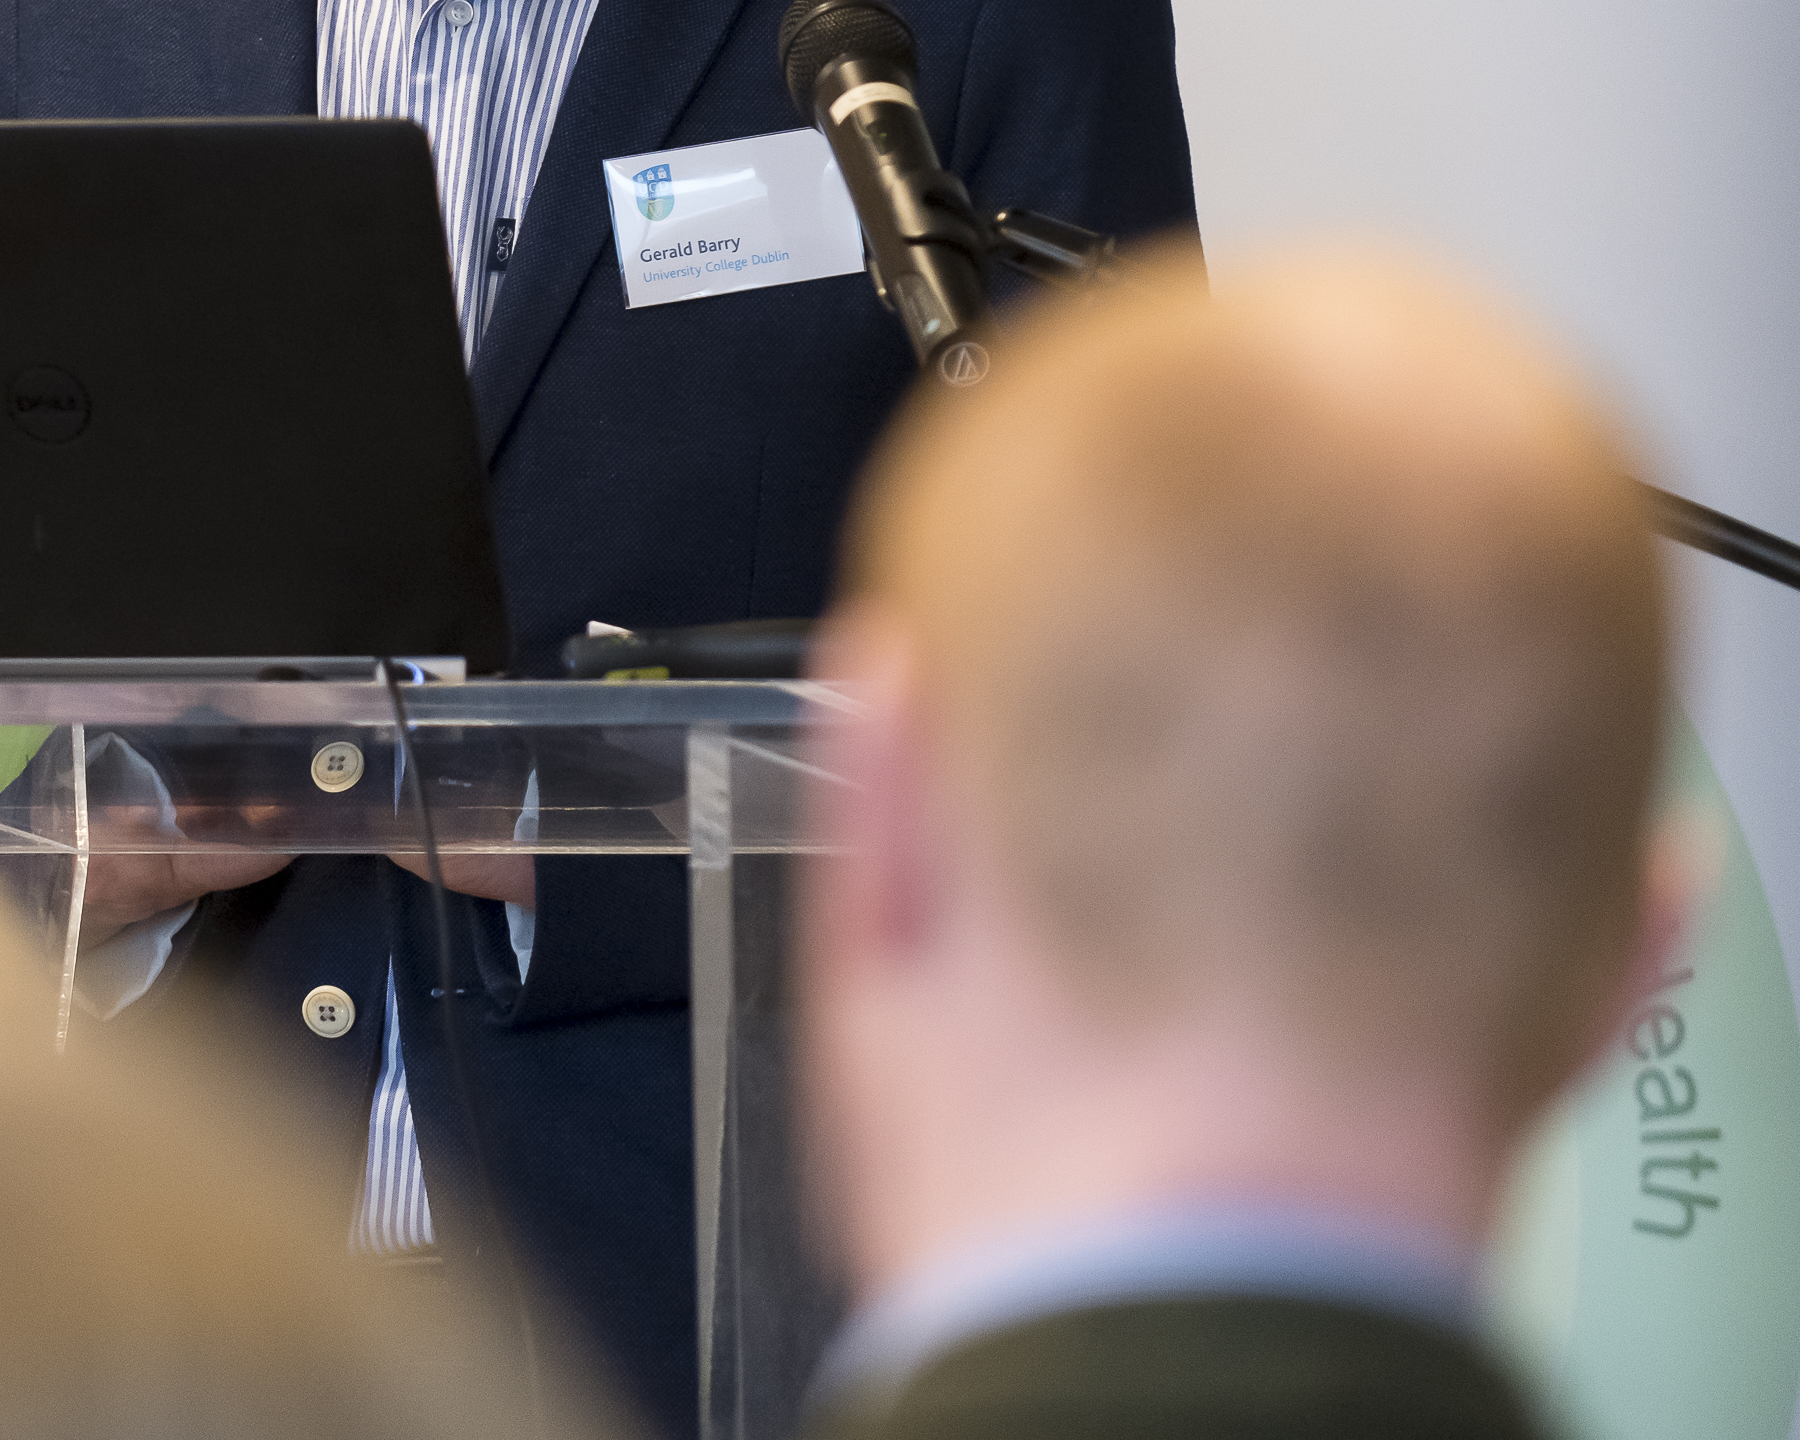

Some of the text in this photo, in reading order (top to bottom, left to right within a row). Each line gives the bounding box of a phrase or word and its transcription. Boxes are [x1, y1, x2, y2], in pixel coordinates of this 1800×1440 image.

[640, 237, 741, 263] Gerald Barry
[643, 250, 790, 283] University College Dublin
